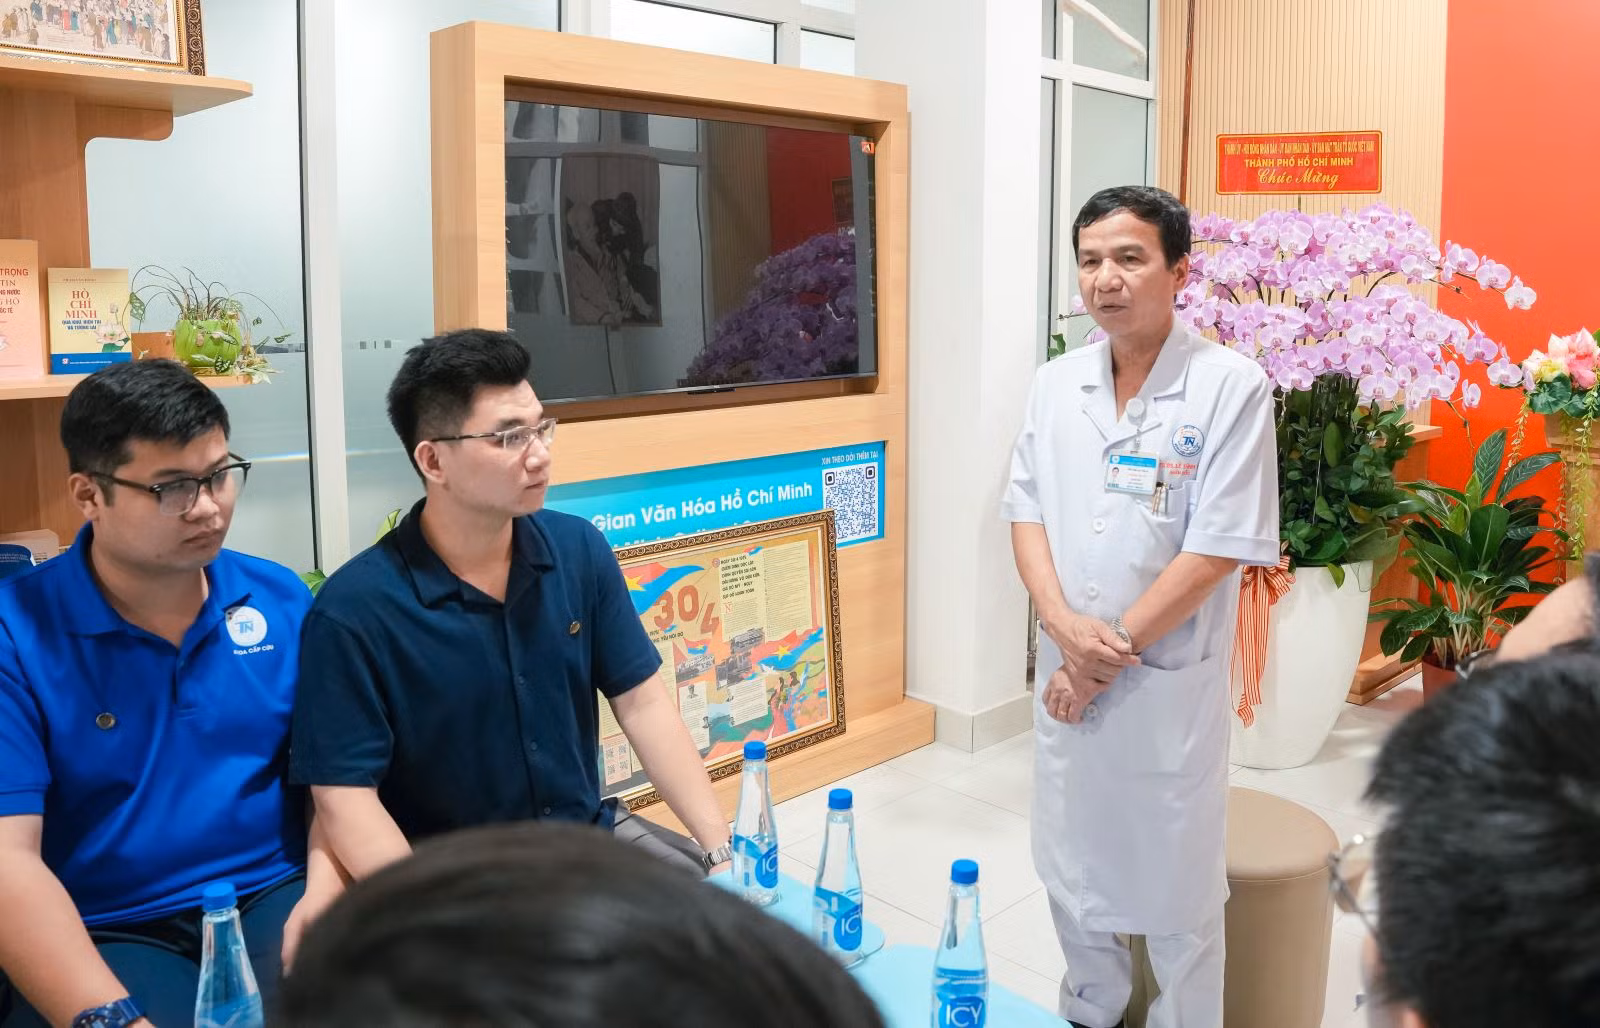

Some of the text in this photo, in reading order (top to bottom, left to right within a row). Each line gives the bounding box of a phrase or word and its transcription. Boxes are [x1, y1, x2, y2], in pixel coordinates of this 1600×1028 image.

[1244, 157, 1275, 168] THÀNH
[1277, 155, 1295, 167] PHỐ
[1312, 155, 1328, 166] CHÍ
[1330, 157, 1354, 166] MINH
[1258, 167, 1339, 190] Chúc Mừng
[66, 310, 97, 319] MINH
[70, 298, 91, 309] CHÍ
[592, 482, 813, 531] Gian Văn Hóa Hồ Chí Minh
[762, 854, 778, 876] IC
[842, 914, 861, 937] IC
[946, 1002, 983, 1027] ICY
